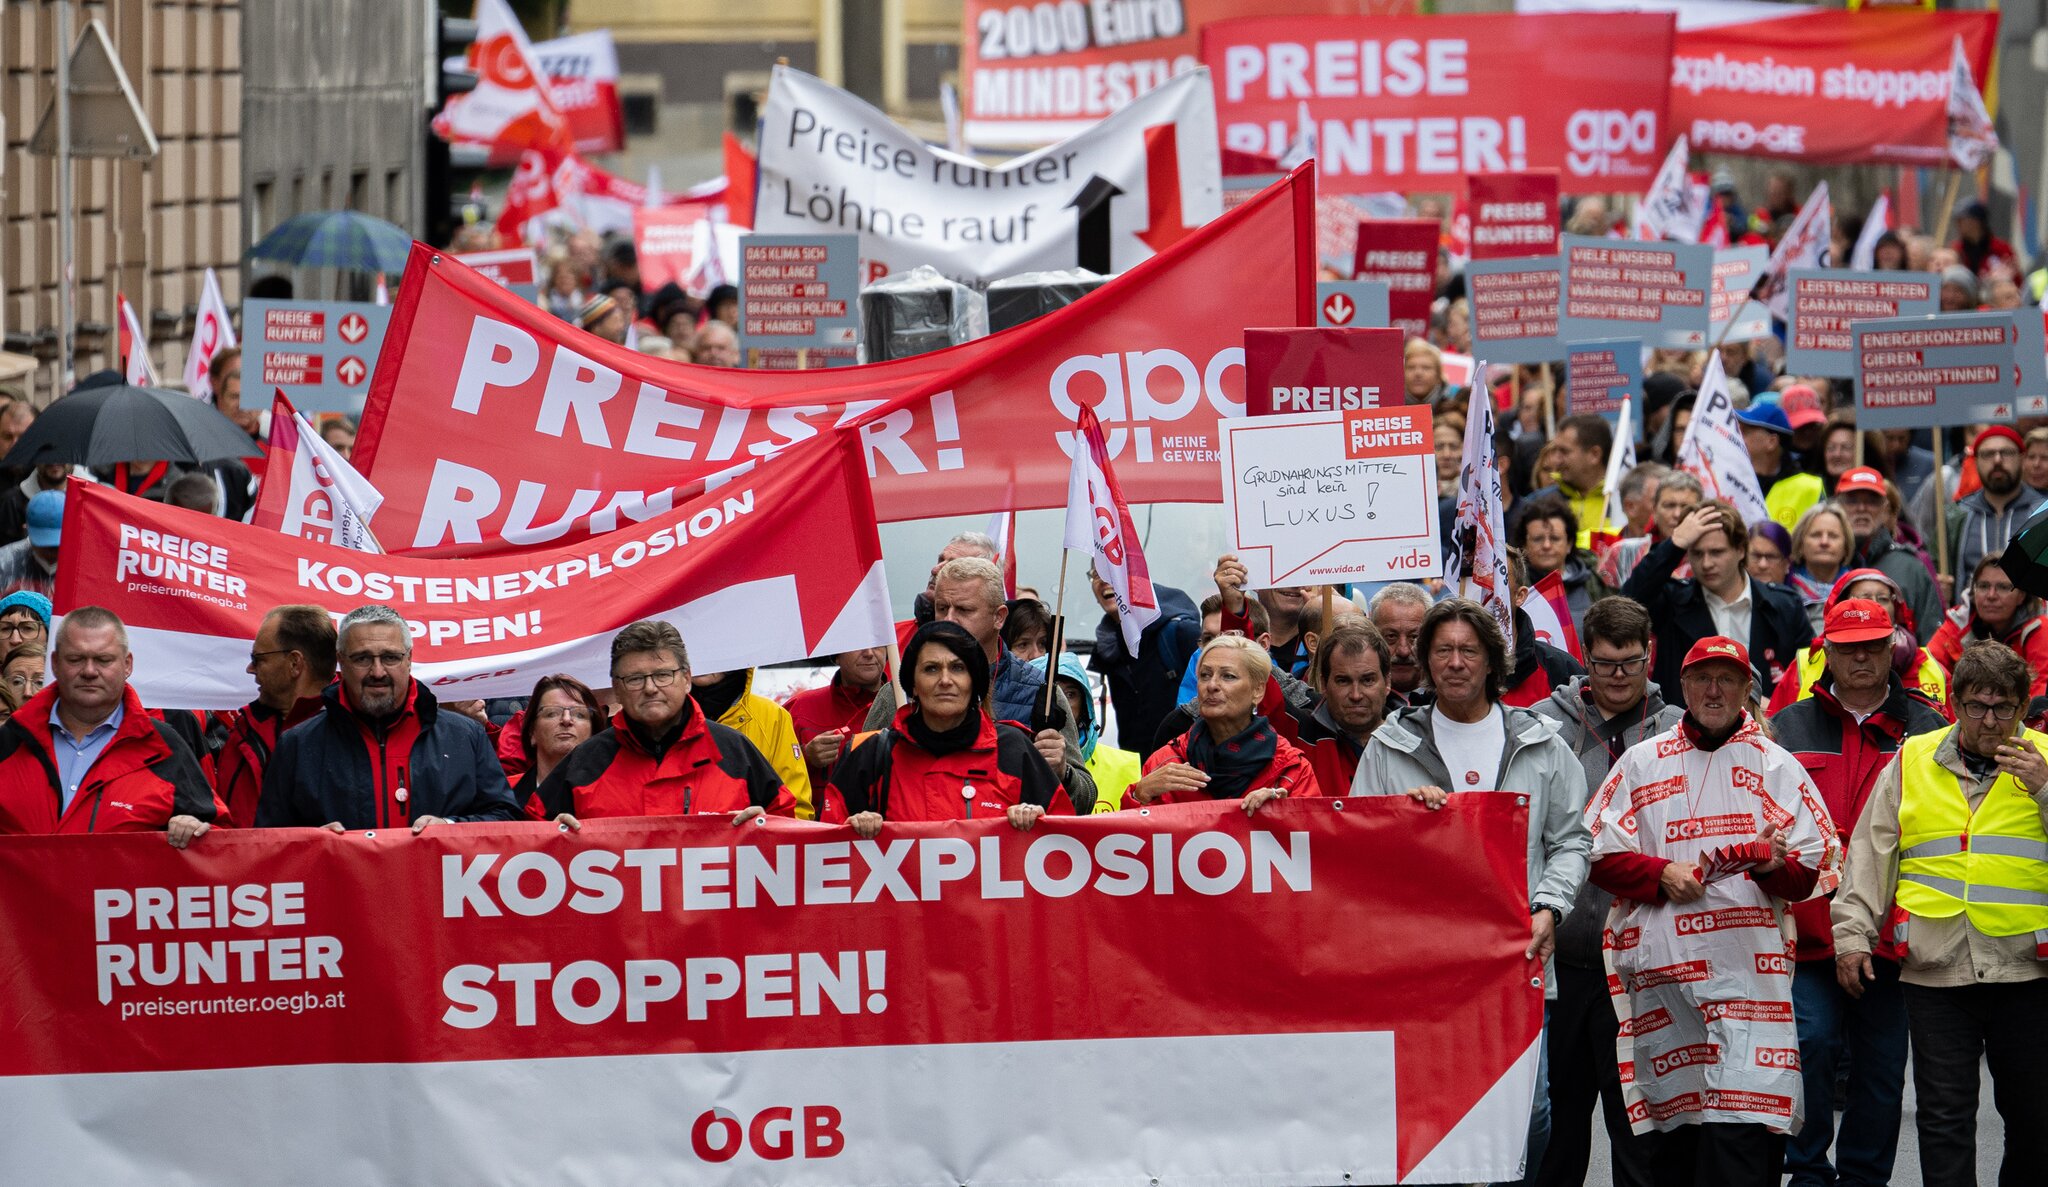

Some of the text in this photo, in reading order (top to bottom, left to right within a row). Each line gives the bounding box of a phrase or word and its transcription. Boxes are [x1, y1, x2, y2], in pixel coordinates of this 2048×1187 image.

[978, 0, 1182, 60] 2000 Euro
[1225, 39, 1469, 100] PREISE
[787, 107, 917, 178] Preise
[1225, 116, 1527, 176] RNTER!
[1692, 120, 1806, 154] PRO-GE
[784, 178, 1035, 243] Löhne rauf
[1480, 202, 1546, 222] PREISE
[1474, 225, 1555, 245] RUNTER!
[1571, 248, 1673, 267] VIELE UNSERER
[1571, 268, 1621, 281] KINDER
[1570, 286, 1638, 301] WÄHREND
[1641, 288, 1662, 302] DIE
[1799, 280, 1877, 297] LEISTBARES
[267, 312, 312, 325] PREISE
[1570, 304, 1660, 320] DISKUTIEREN!
[267, 327, 322, 342] RUNTER!
[1799, 317, 1839, 331] STATT
[1863, 327, 2002, 349] ENERGIEKONZERNE
[265, 353, 309, 367] LÖHNE
[1863, 352, 1921, 368] GIEREN,
[265, 370, 305, 383] RAUF!
[1864, 367, 1997, 387] PENSIONISTINNEN
[1272, 386, 1380, 411] PREISE
[1866, 387, 1934, 407] FRIEREN!
[1350, 416, 1412, 436] PREISE
[1162, 436, 1207, 449] MEINE
[1351, 431, 1424, 454] RUNTER
[1276, 480, 1347, 498] sind kein
[1263, 500, 1356, 527] LUXUS
[119, 523, 228, 570] PREISE
[298, 489, 755, 604] KOSTENEXPLOSION
[116, 548, 247, 598] RUNTER
[1309, 548, 1431, 576] www.vida.at vida
[127, 580, 248, 611] preiserunter.oegb.at
[441, 829, 1312, 918] KOSTENEXPLOSION
[94, 881, 305, 941] PREISE
[97, 935, 344, 1006] RUNTER
[441, 949, 888, 1029] STOPPEN!
[120, 989, 345, 1020] preiserunter.oegb.at
